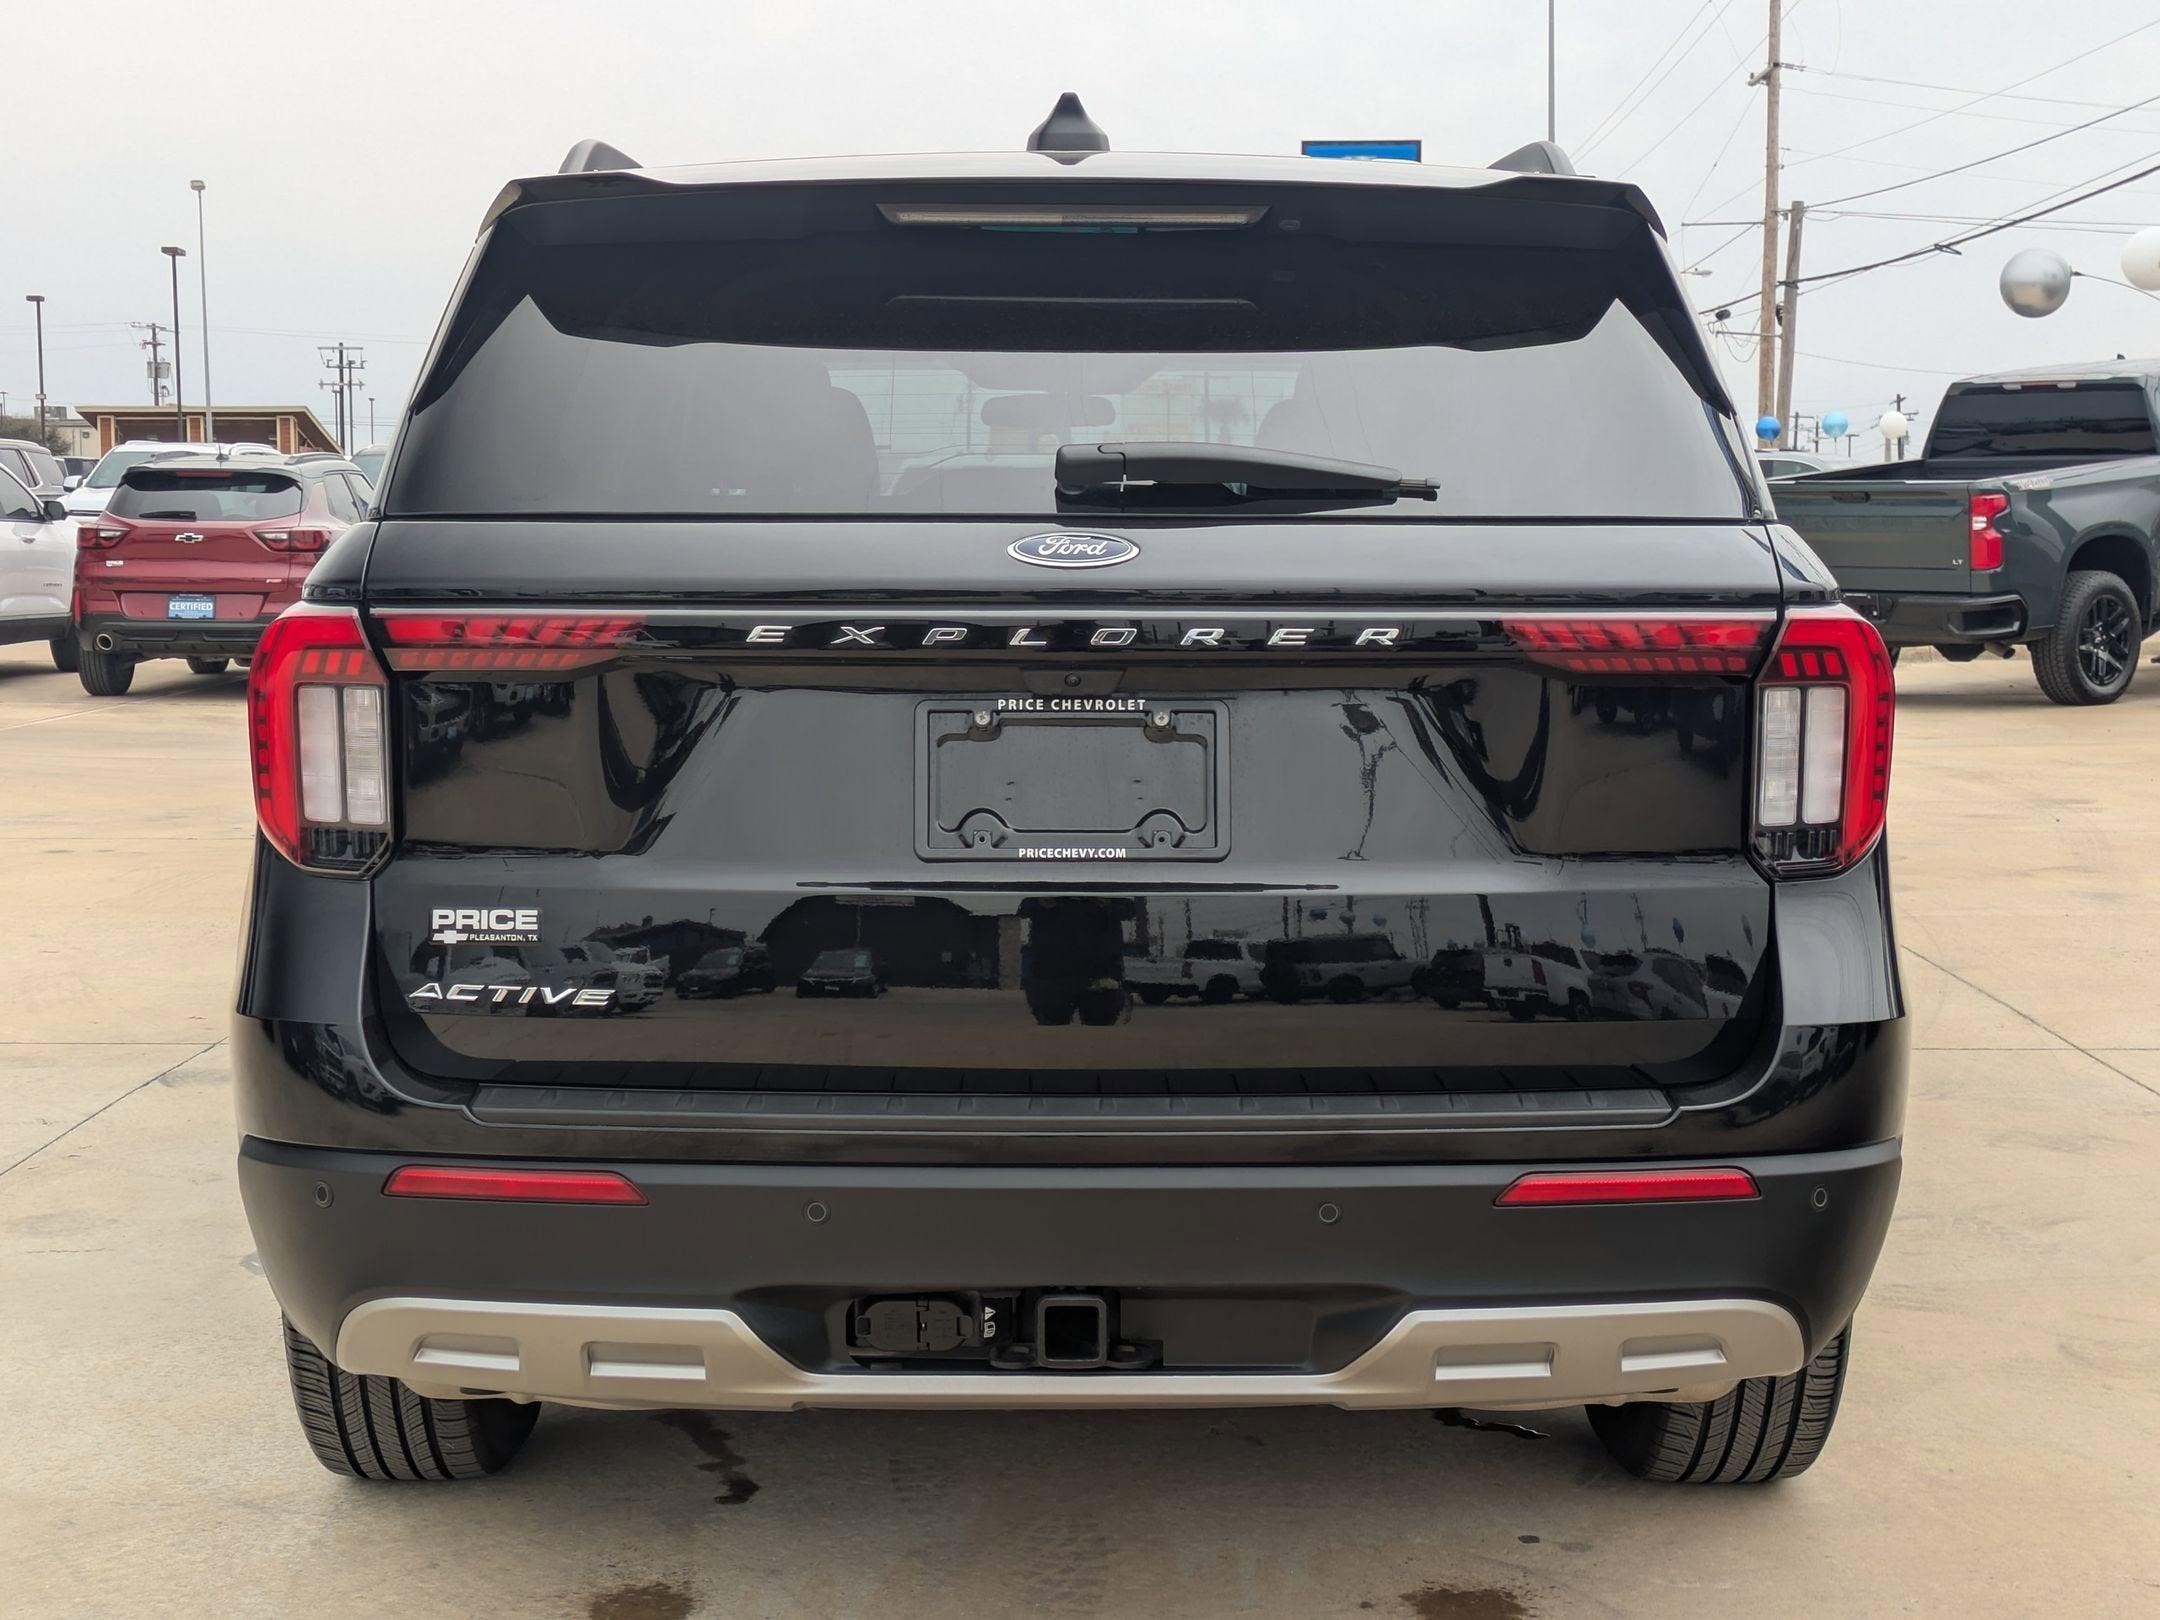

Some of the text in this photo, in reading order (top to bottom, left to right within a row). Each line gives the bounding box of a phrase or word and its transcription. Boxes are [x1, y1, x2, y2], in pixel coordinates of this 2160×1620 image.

[1038, 535, 1107, 555] Ford
[169, 602, 213, 611] CERTIFIED
[745, 625, 1400, 647] EXPLORER
[997, 699, 1146, 711] PRICE CHEVROLET
[1018, 847, 1127, 859] PRICECHEVY.COM
[432, 909, 538, 930] PRICE
[469, 933, 538, 942] PLEASANTON, TX
[409, 983, 616, 1006] ACTIVE
